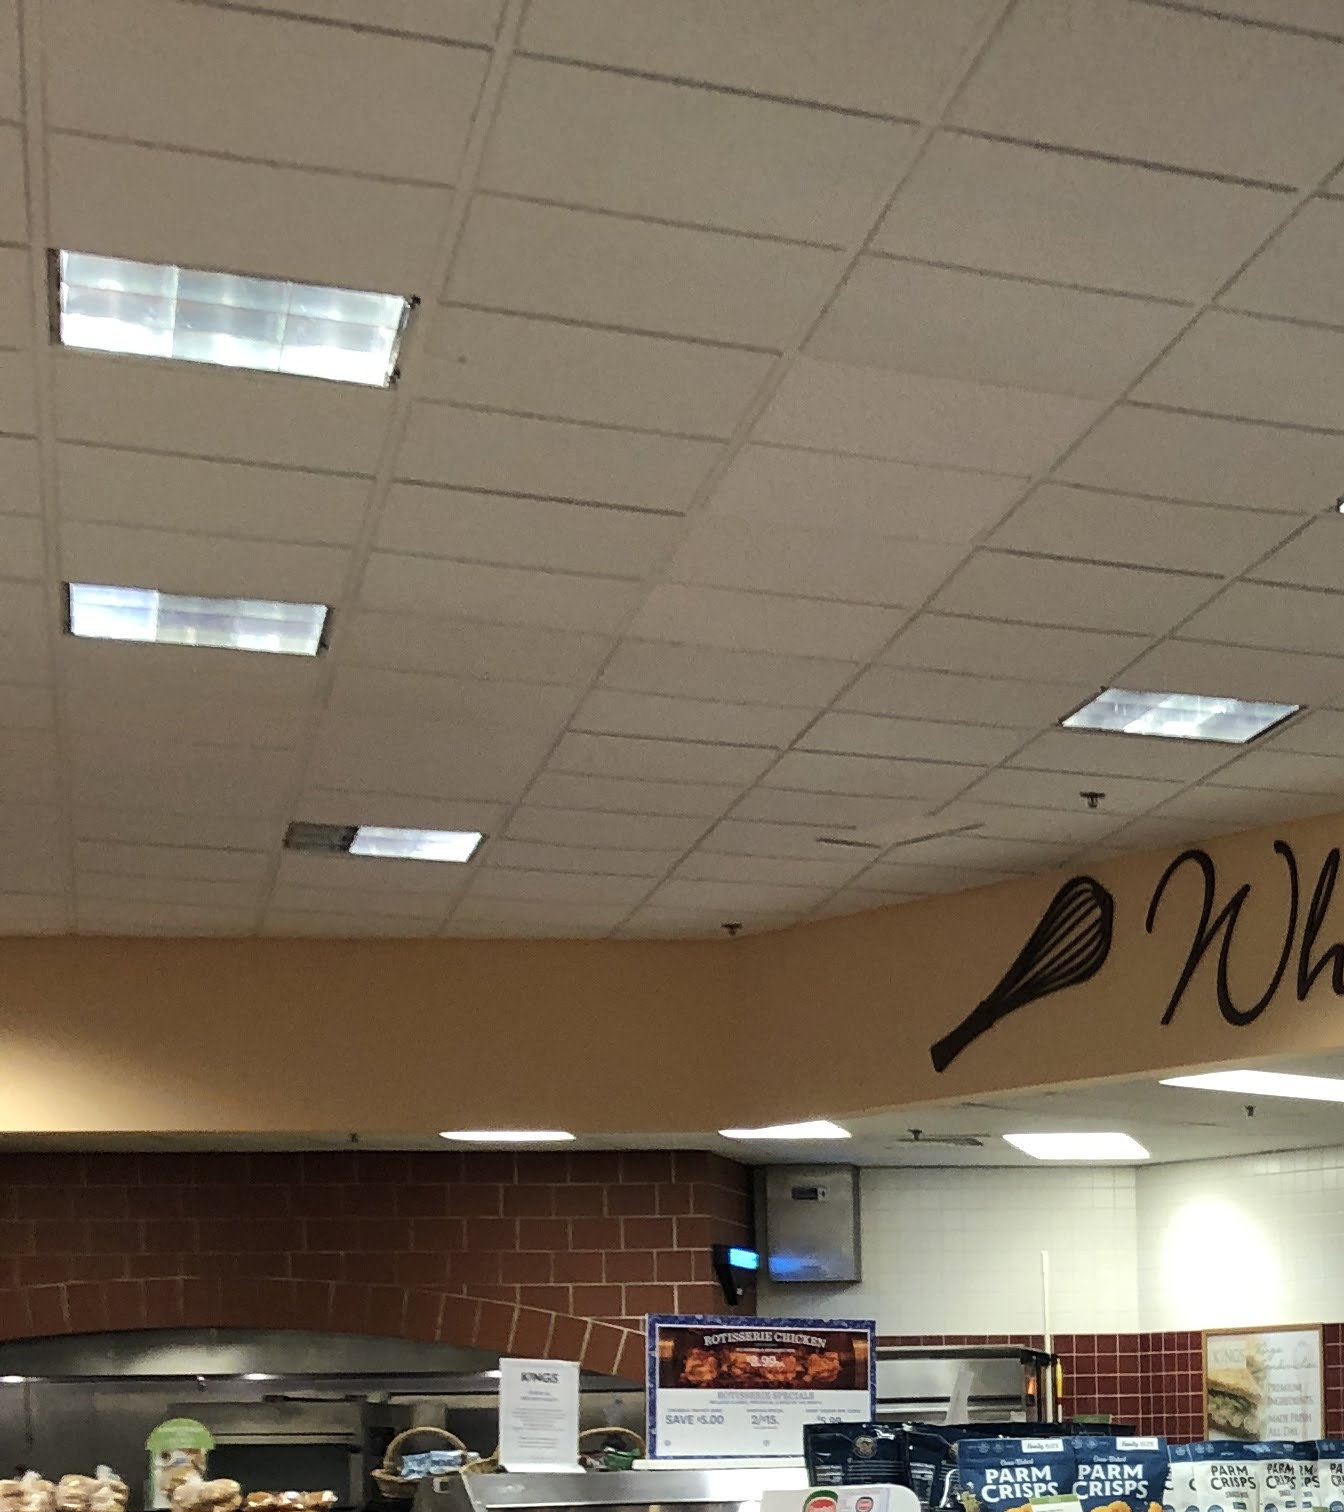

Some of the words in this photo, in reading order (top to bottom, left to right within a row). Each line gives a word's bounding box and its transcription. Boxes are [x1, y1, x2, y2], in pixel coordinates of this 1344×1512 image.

[704, 1331, 773, 1347] ROTISSERIE
[774, 1331, 827, 1349] CHICKEN
[665, 1415, 694, 1425] SAVE
[985, 1465, 1052, 1483] PARM
[1078, 1464, 1144, 1480] PARM
[1211, 1465, 1249, 1476] PARM
[1266, 1463, 1295, 1475] PARM
[1072, 1480, 1149, 1500] CRISPS
[1211, 1476, 1257, 1490] CRISPS
[981, 1482, 1059, 1503] CRISPS
